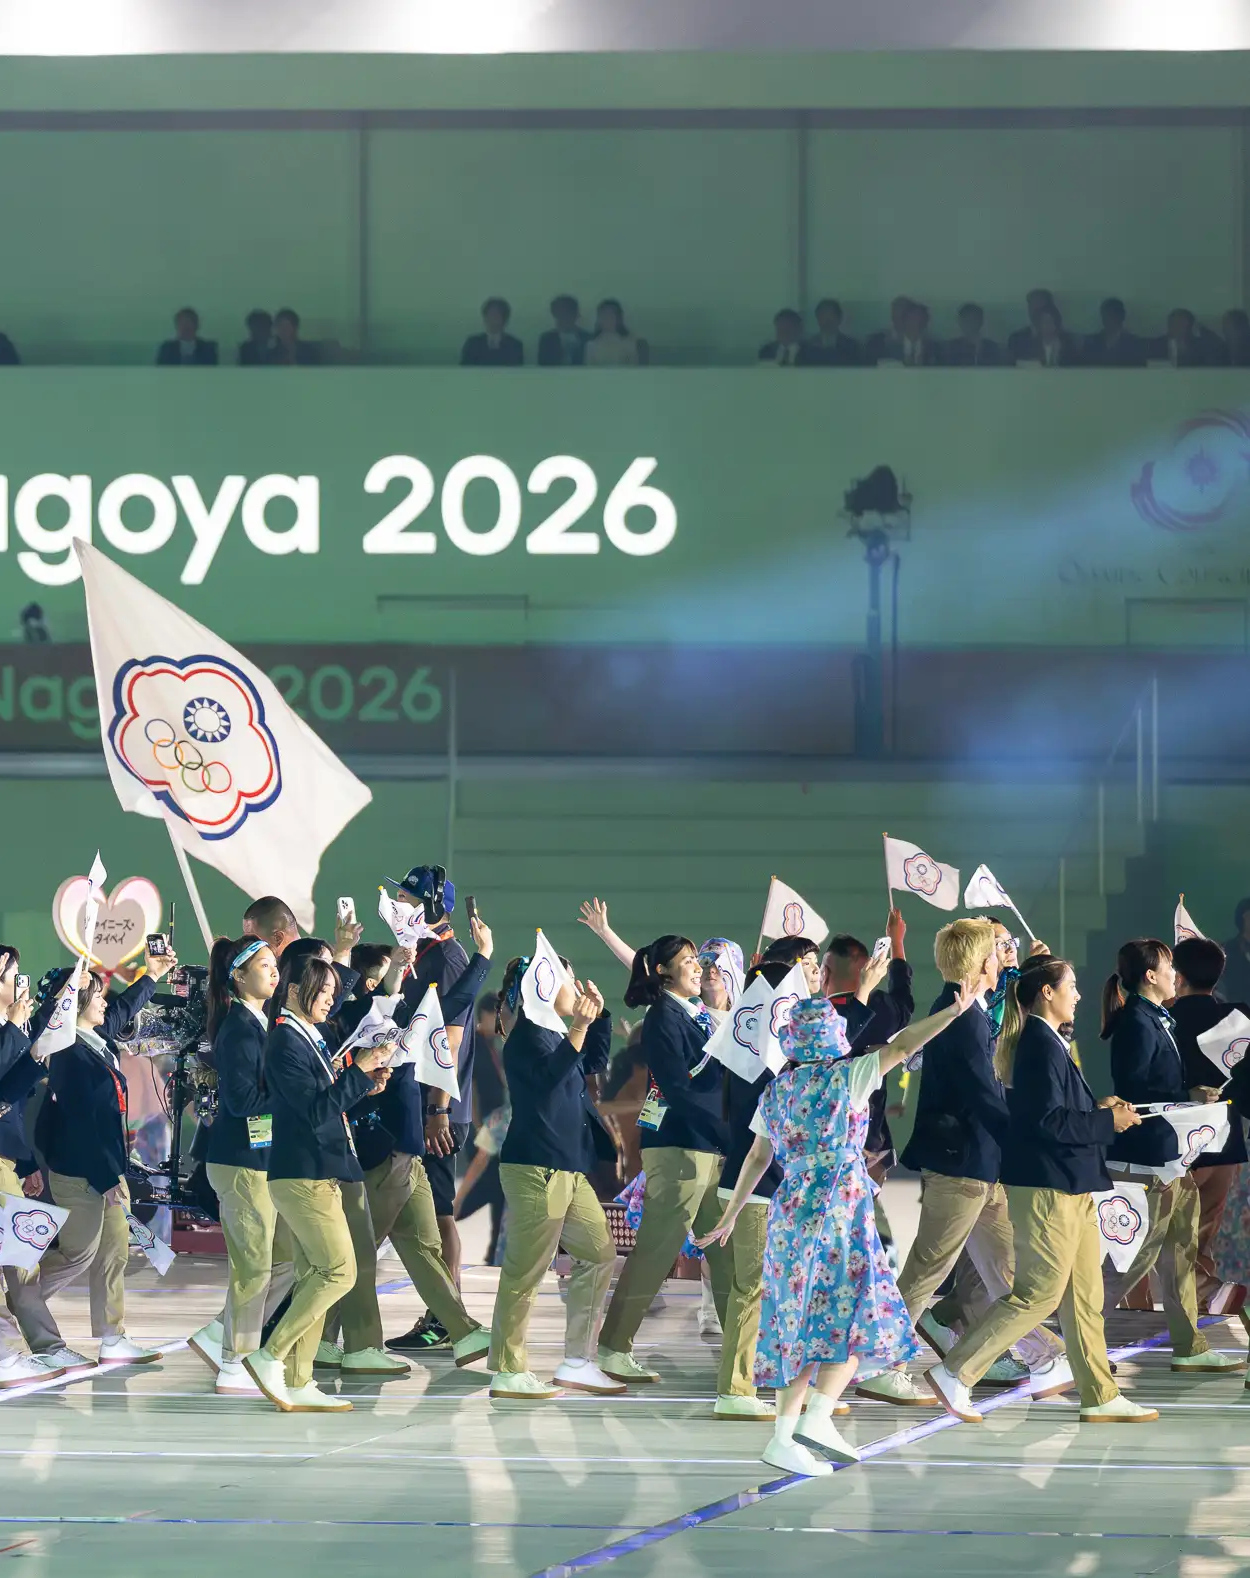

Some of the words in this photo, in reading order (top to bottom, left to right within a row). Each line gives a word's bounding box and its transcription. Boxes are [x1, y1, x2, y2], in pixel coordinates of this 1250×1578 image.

[362, 454, 678, 557] 2026
[94, 932, 126, 945] タイペイ
